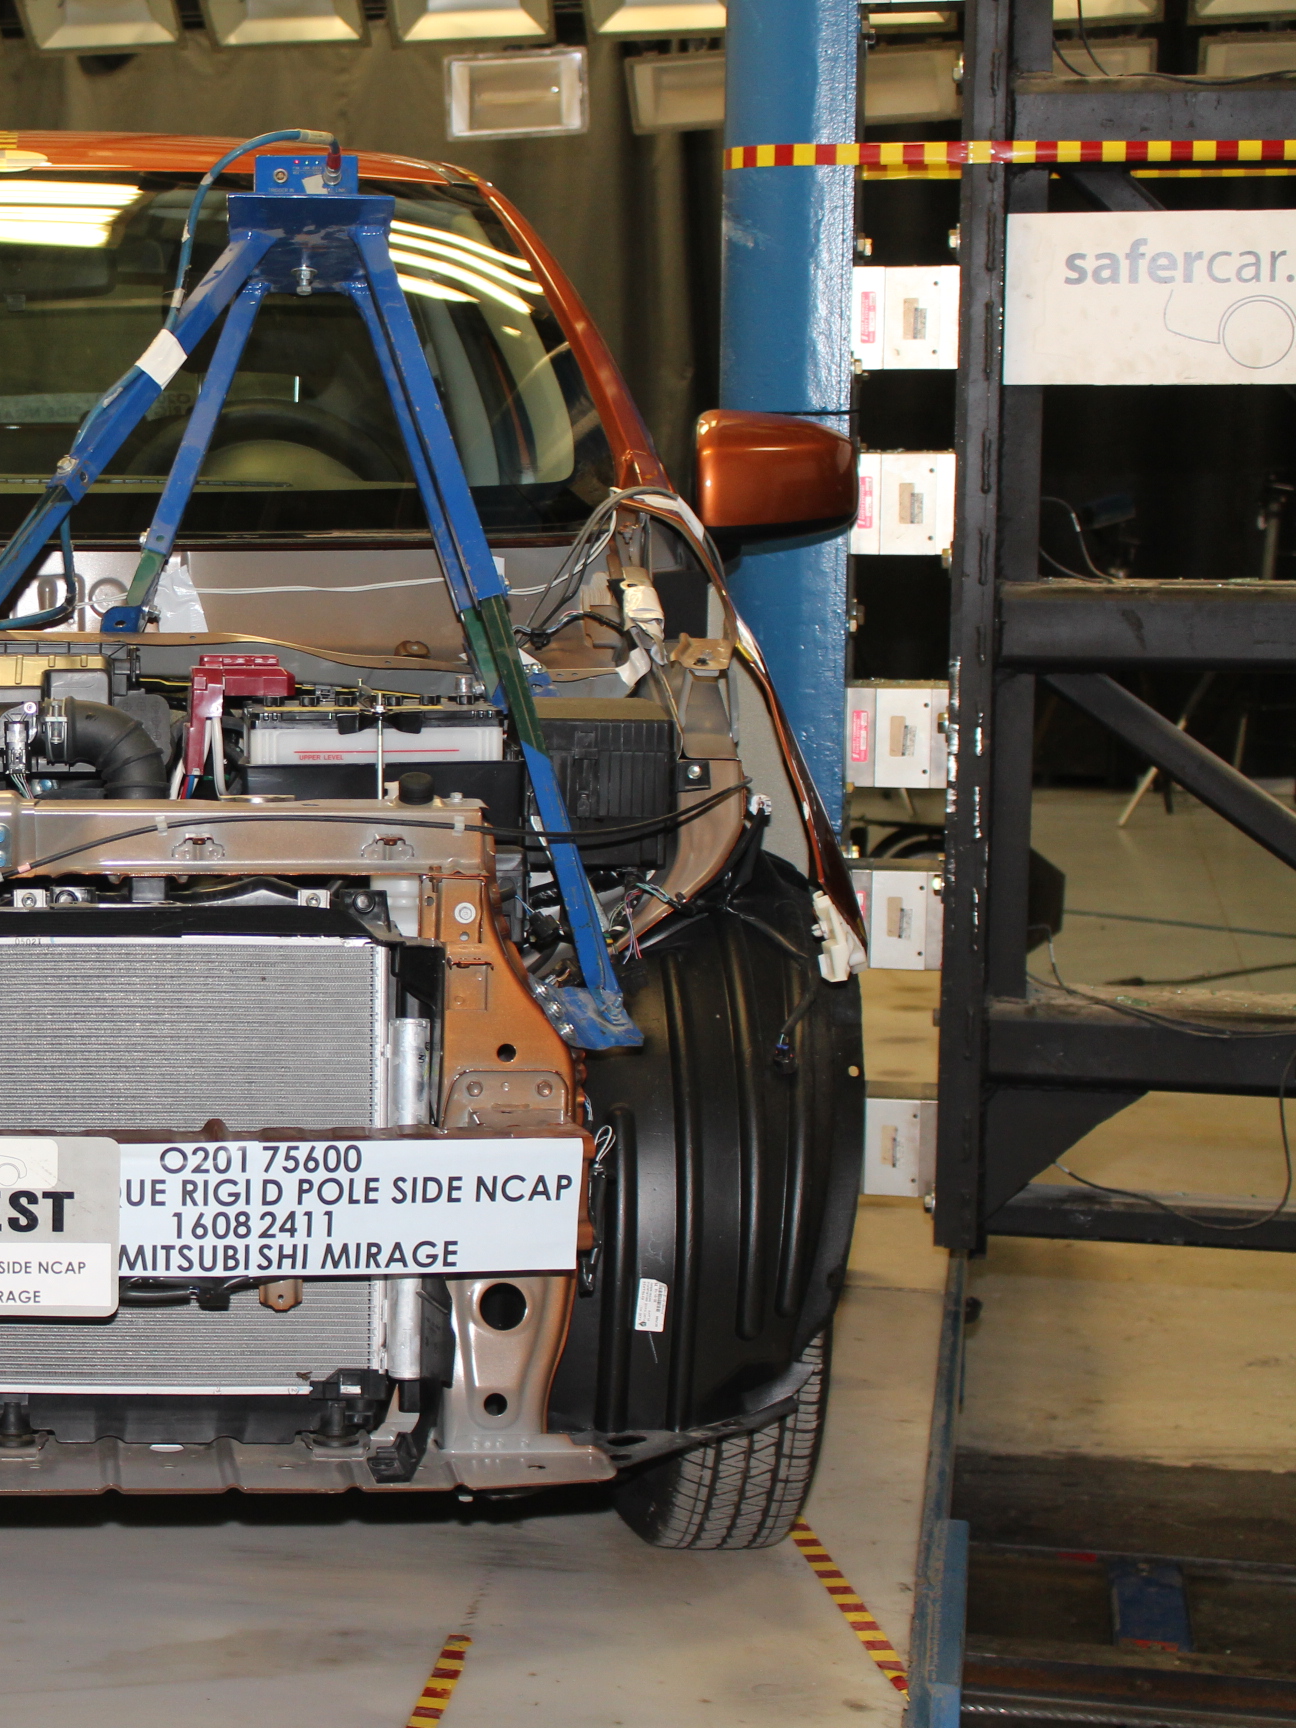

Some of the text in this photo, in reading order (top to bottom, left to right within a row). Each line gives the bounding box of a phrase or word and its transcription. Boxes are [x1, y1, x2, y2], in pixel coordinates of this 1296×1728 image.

[119, 1178, 167, 1209] UE
[297, 1177, 380, 1207] POLE
[391, 1176, 463, 1205] SIDE
[475, 1174, 573, 1204] NCAP
[38, 1260, 87, 1275] NCAP
[320, 1240, 459, 1271] MIRAGE
